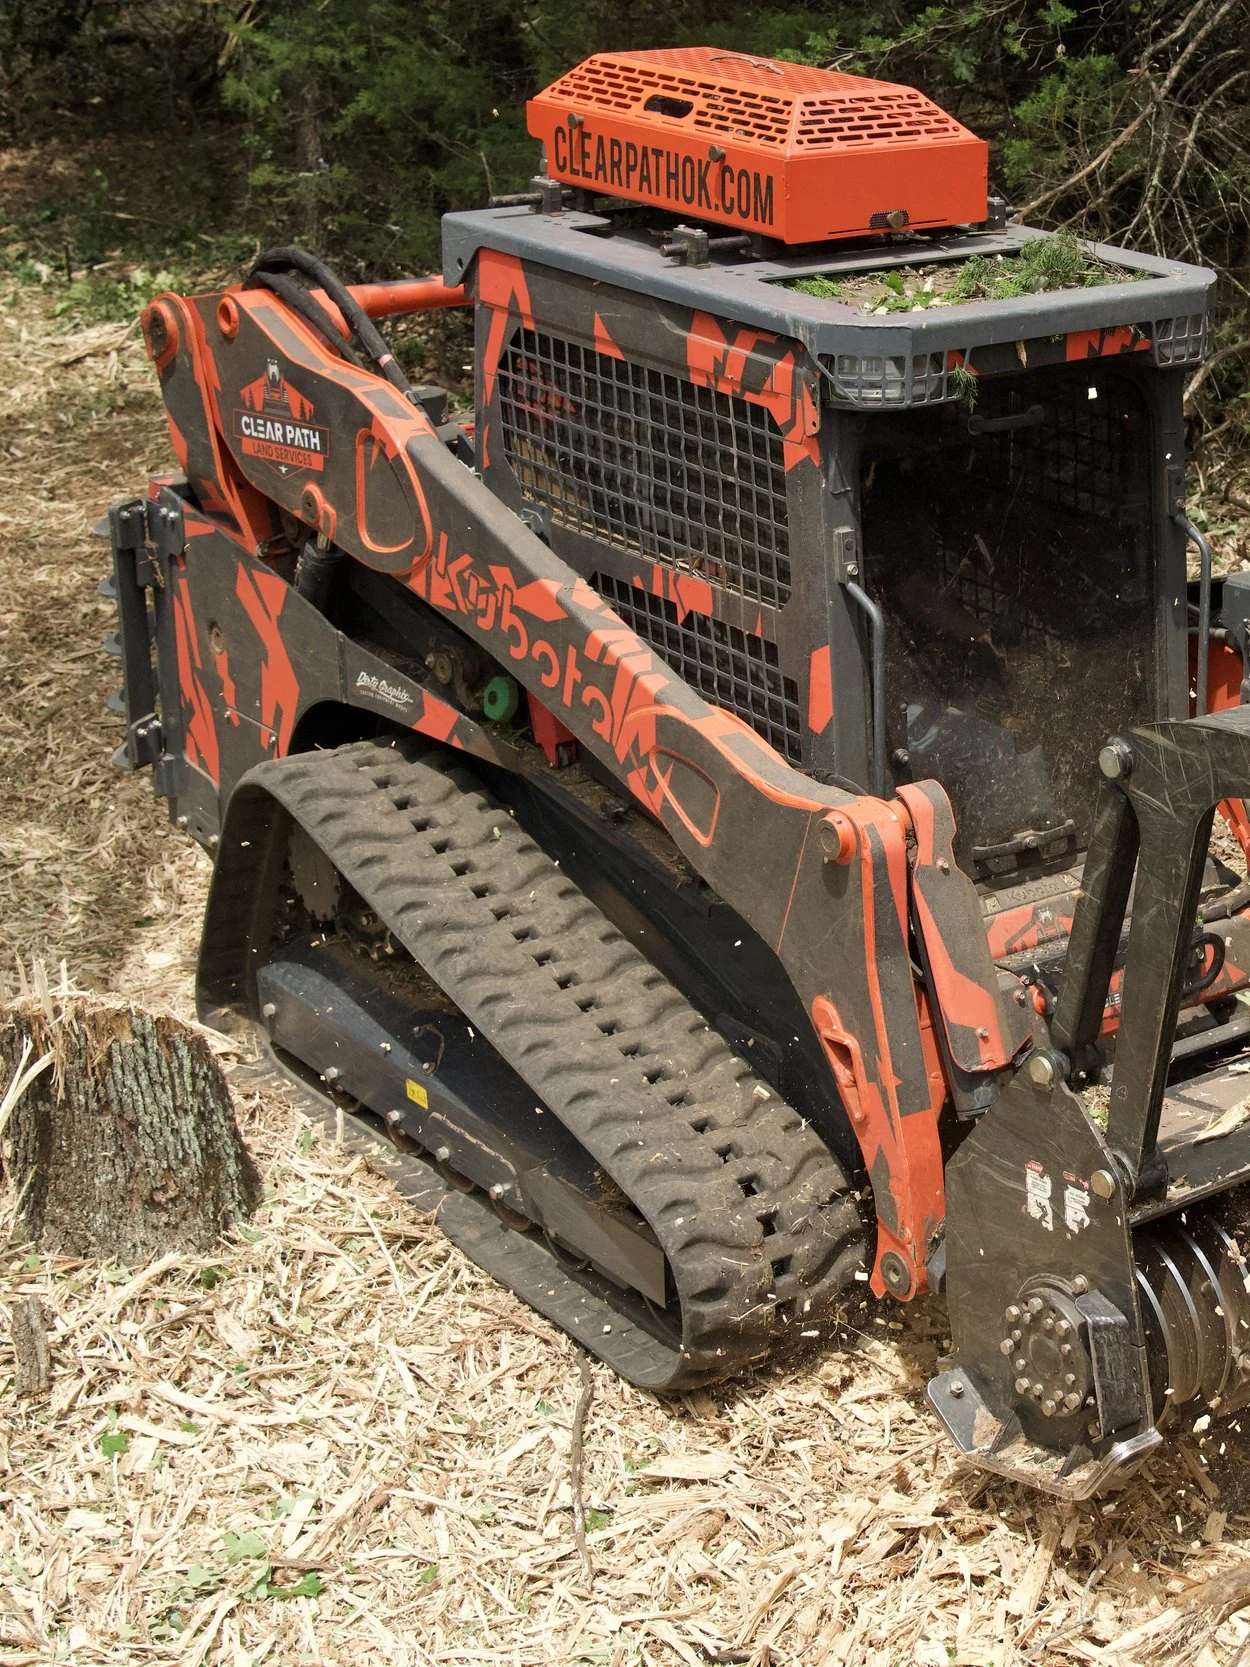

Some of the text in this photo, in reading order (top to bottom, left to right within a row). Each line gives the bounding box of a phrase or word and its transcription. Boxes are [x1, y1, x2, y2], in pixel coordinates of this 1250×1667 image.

[554, 125, 775, 227] CLEARPATHOK.COM
[241, 415, 321, 451] CLEAR PATH
[252, 441, 313, 467] LAND SERVICES
[357, 671, 380, 691] Dirty
